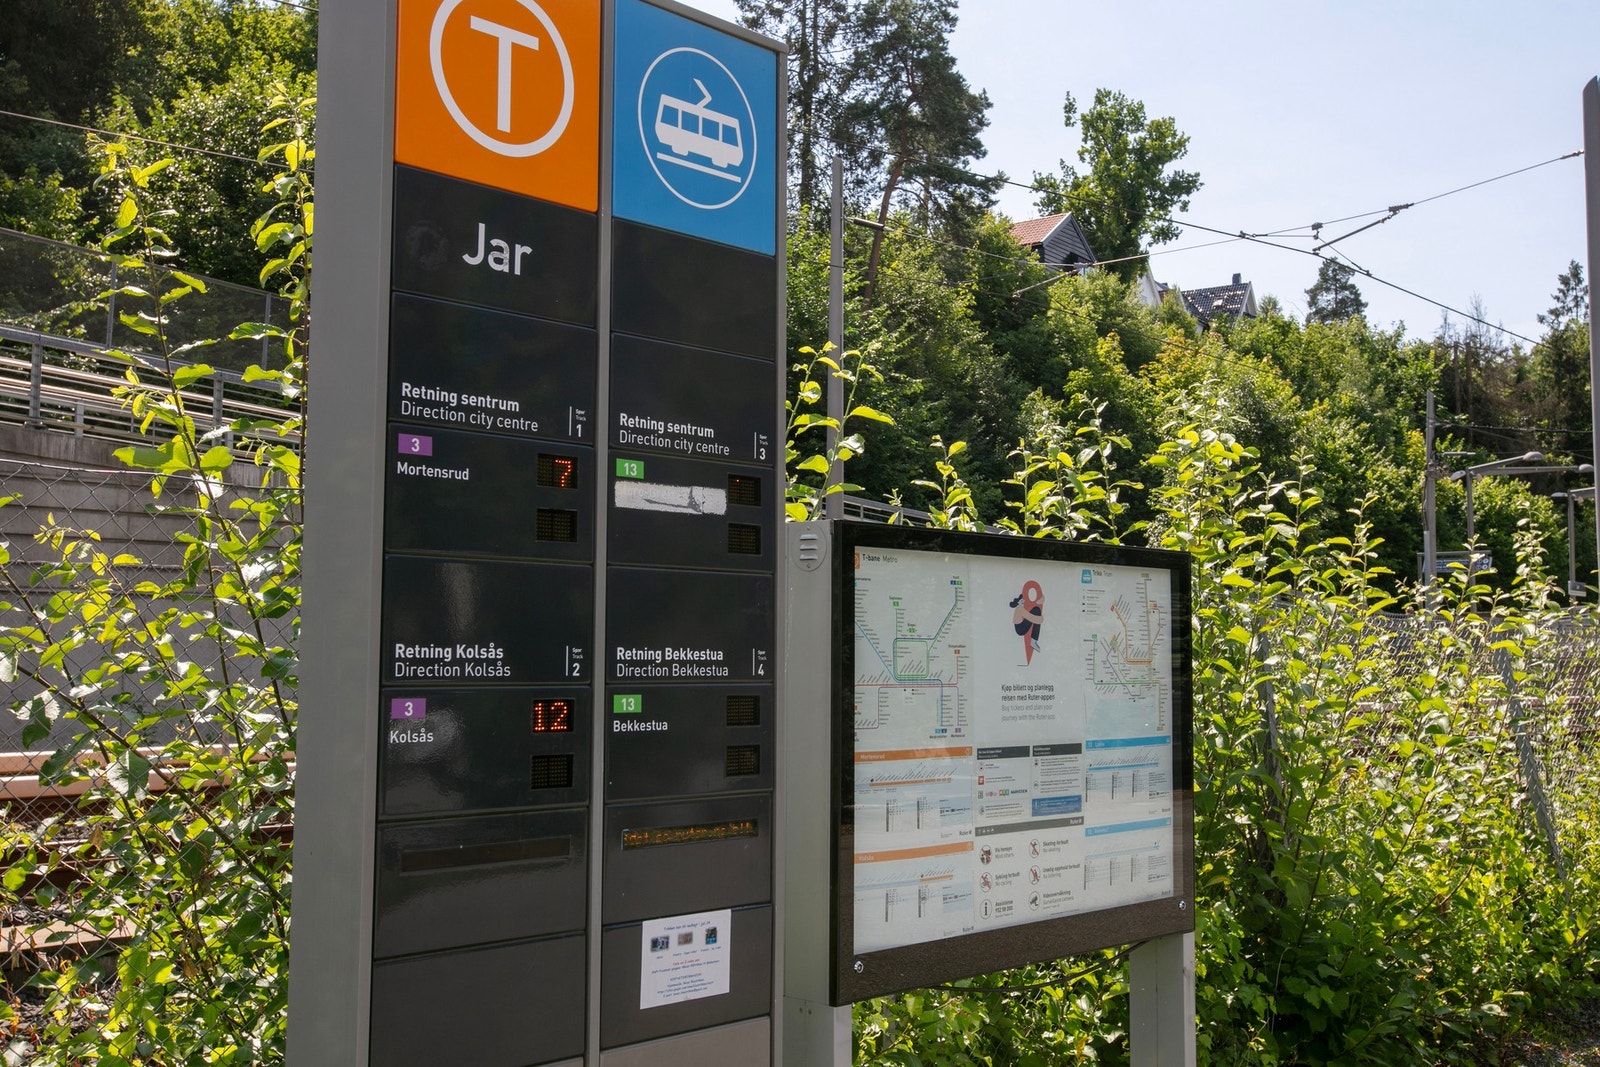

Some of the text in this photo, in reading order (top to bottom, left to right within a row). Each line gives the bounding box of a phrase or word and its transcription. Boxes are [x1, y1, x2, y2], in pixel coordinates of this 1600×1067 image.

[470, 15, 539, 133] T
[462, 223, 533, 276] Jar
[402, 382, 520, 412] Retning sentrum
[401, 400, 538, 432] Direction city centre
[576, 424, 582, 437] 1
[620, 412, 714, 438] Retning sentrum
[411, 438, 420, 452] 3
[620, 430, 730, 456] Direction city centre
[760, 448, 766, 460] 3
[397, 461, 470, 480] Mortensrud
[554, 458, 572, 487] 7
[623, 462, 638, 476] 13
[395, 642, 504, 662] Retning Kolsås
[616, 646, 724, 664] Retning Bekkestua
[395, 660, 511, 677] Direction Kolsås
[572, 662, 580, 677] 2
[616, 664, 728, 677] Direction Bekkestua
[758, 664, 764, 676] 4
[1001, 684, 1012, 692] Kjøp
[1034, 684, 1054, 692] planlegg
[404, 702, 414, 716] 3
[622, 697, 636, 712] 13
[534, 701, 568, 731] 12
[613, 720, 668, 732] Bekkestua
[390, 728, 434, 744] Kolsås
